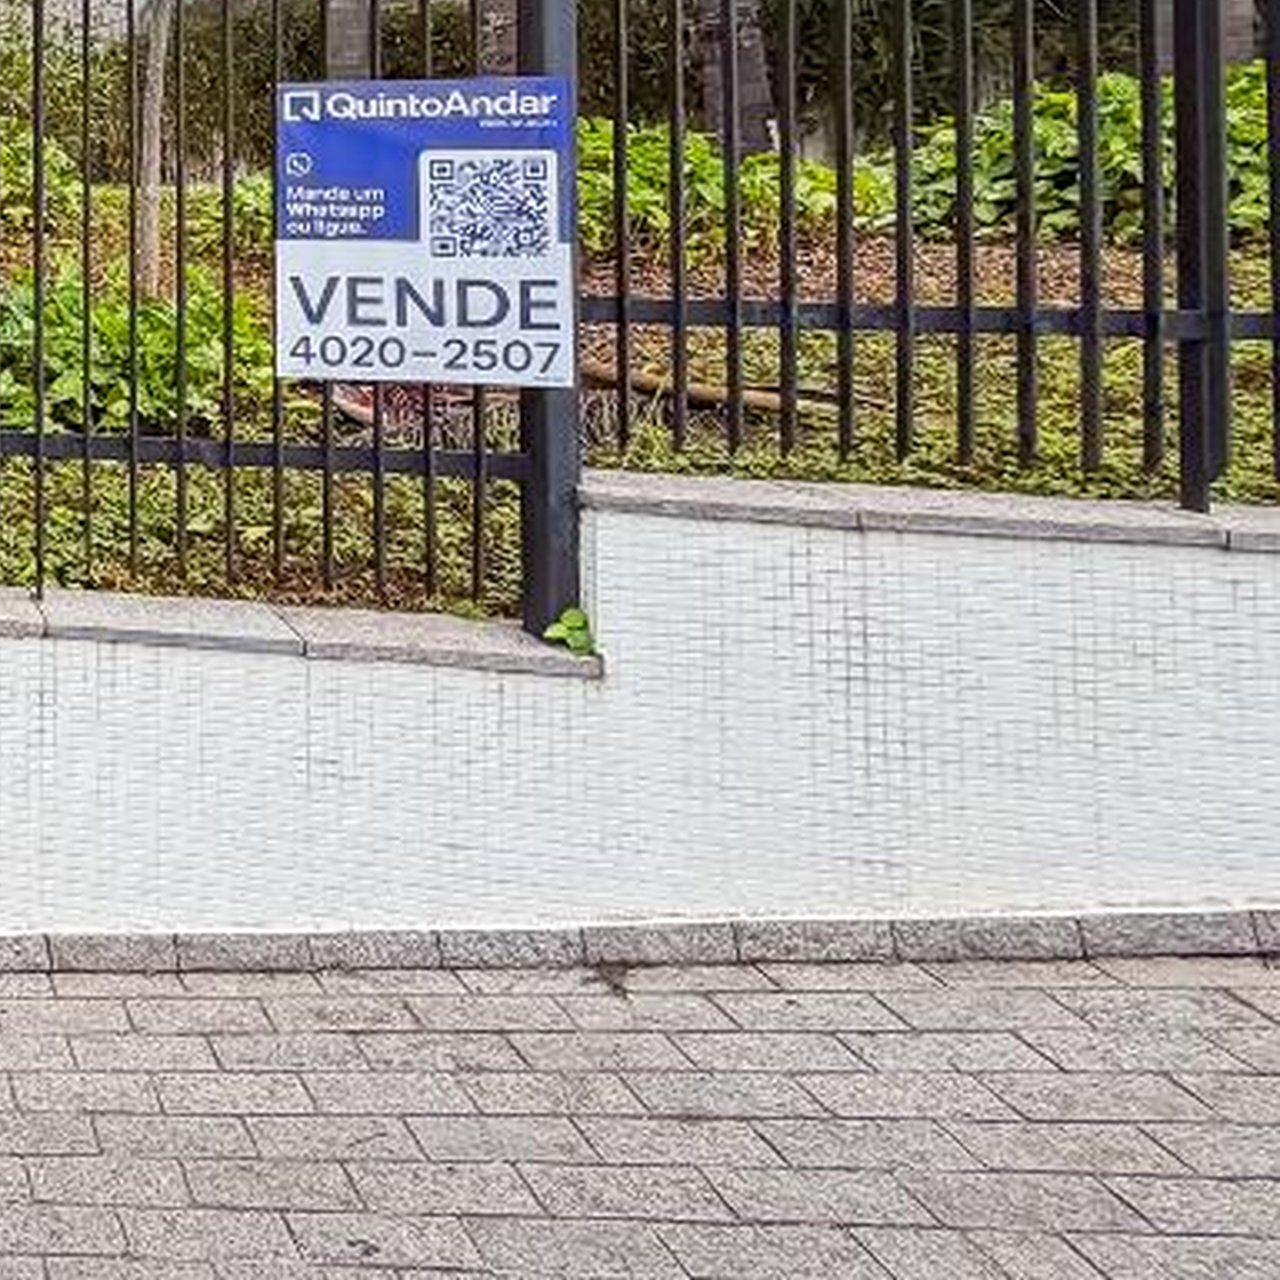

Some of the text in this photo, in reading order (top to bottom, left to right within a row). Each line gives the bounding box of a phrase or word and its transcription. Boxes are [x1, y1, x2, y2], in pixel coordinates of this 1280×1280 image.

[326, 90, 558, 120] QuintoAndar
[286, 185, 385, 201] Mande um
[286, 203, 386, 221] Whatsapp
[286, 221, 312, 234] ou
[289, 276, 561, 331] VENDE
[289, 335, 561, 374] 4020-2507
